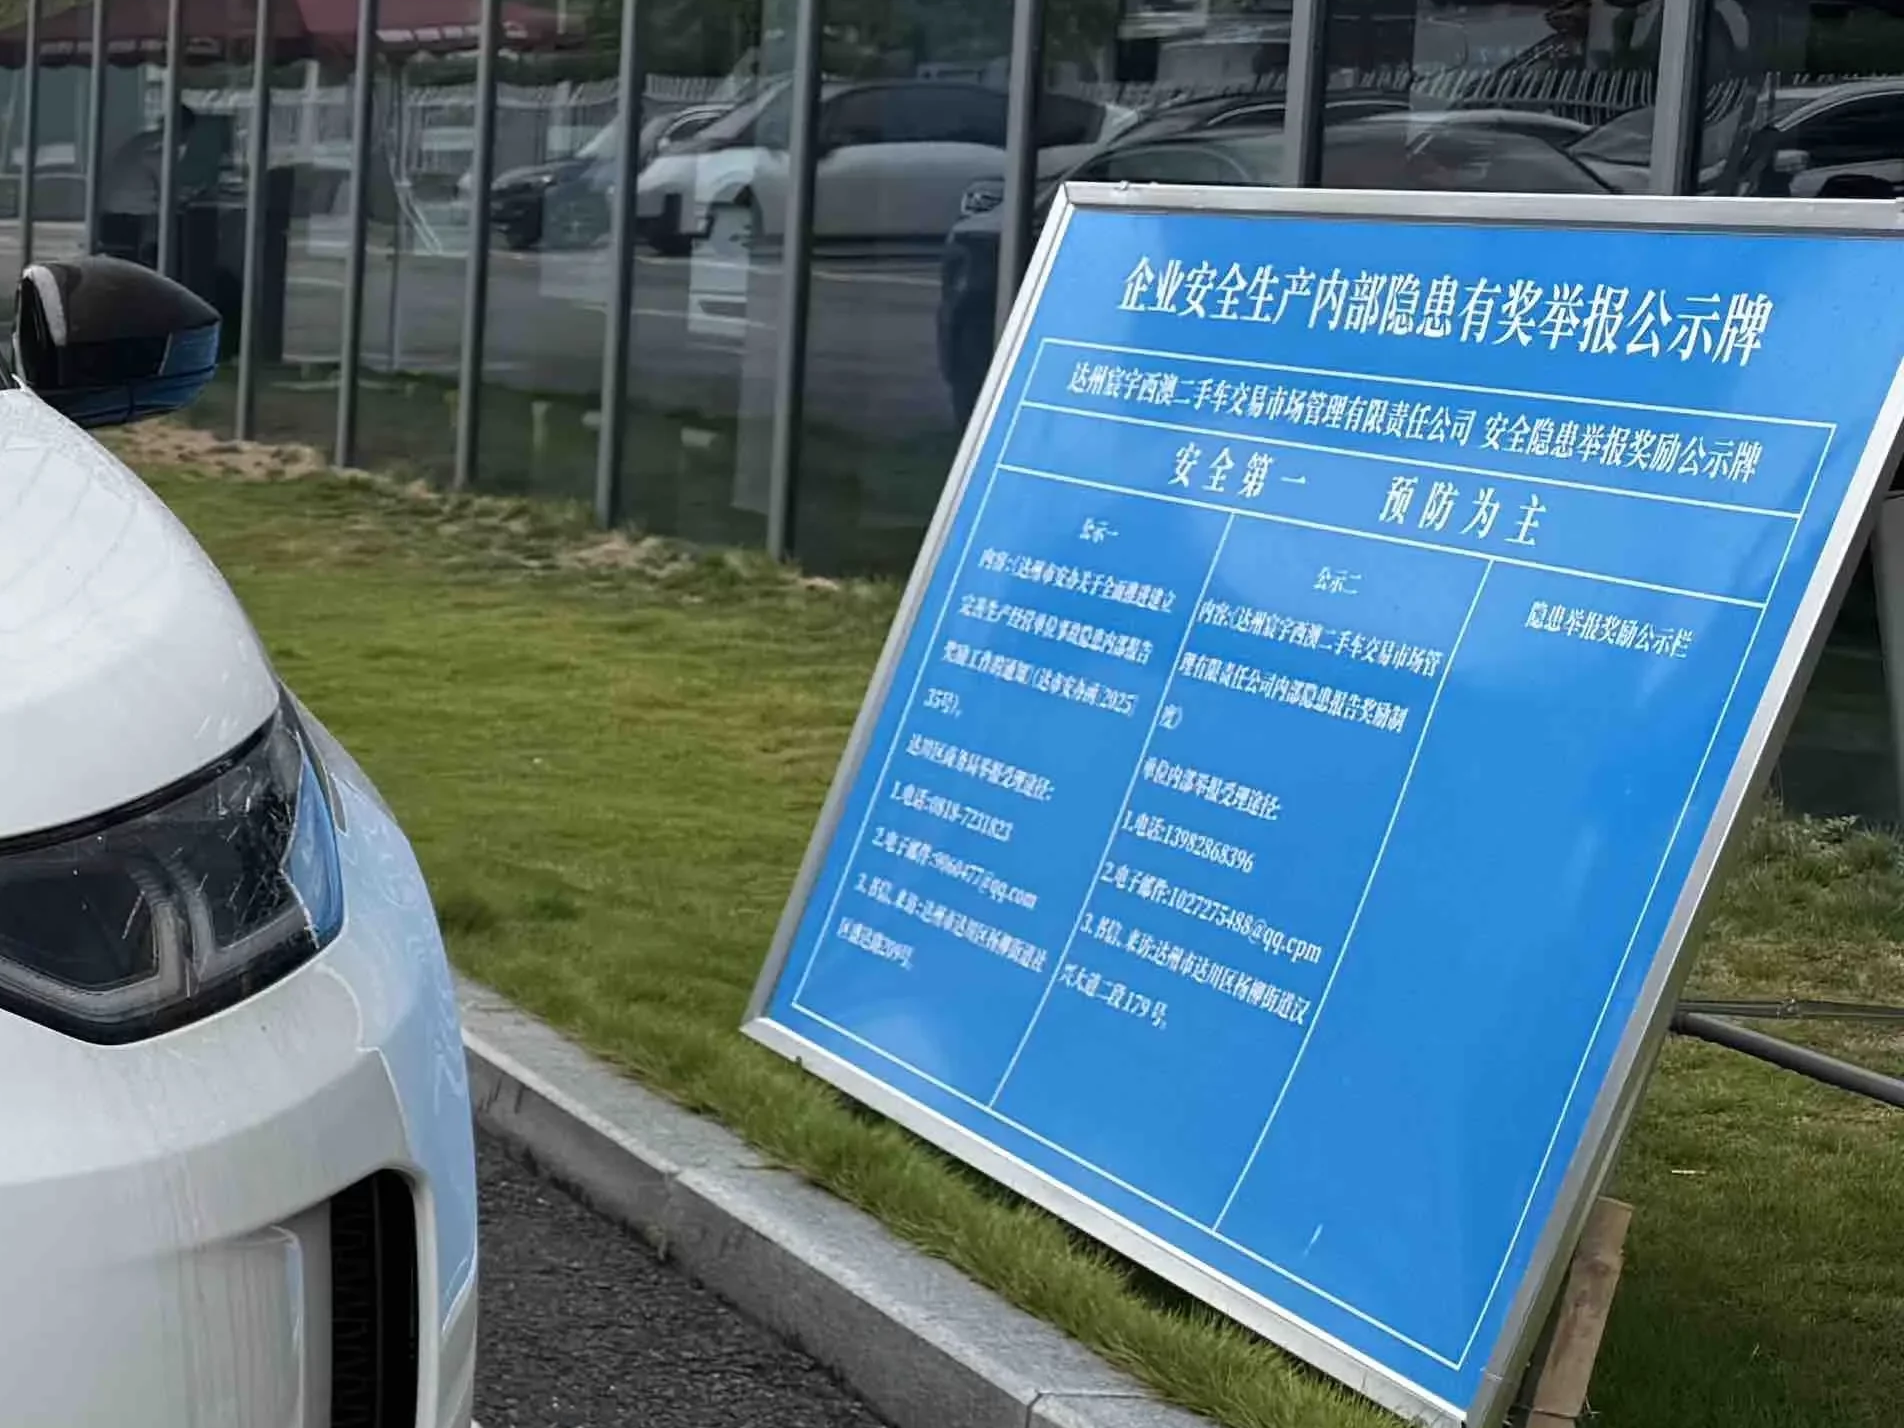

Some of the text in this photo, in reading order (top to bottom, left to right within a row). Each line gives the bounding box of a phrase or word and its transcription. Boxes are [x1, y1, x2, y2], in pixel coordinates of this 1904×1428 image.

[1116, 255, 1774, 367] 企业安全生产内部隐患有奖举报公示牌
[1479, 410, 1763, 484] 安全隐患举报奖励公示牌
[1166, 440, 1547, 546] 安全第一 预防为主
[1312, 565, 1362, 594] 公示二
[1523, 600, 1693, 658] 隐患举报奖励公示栏
